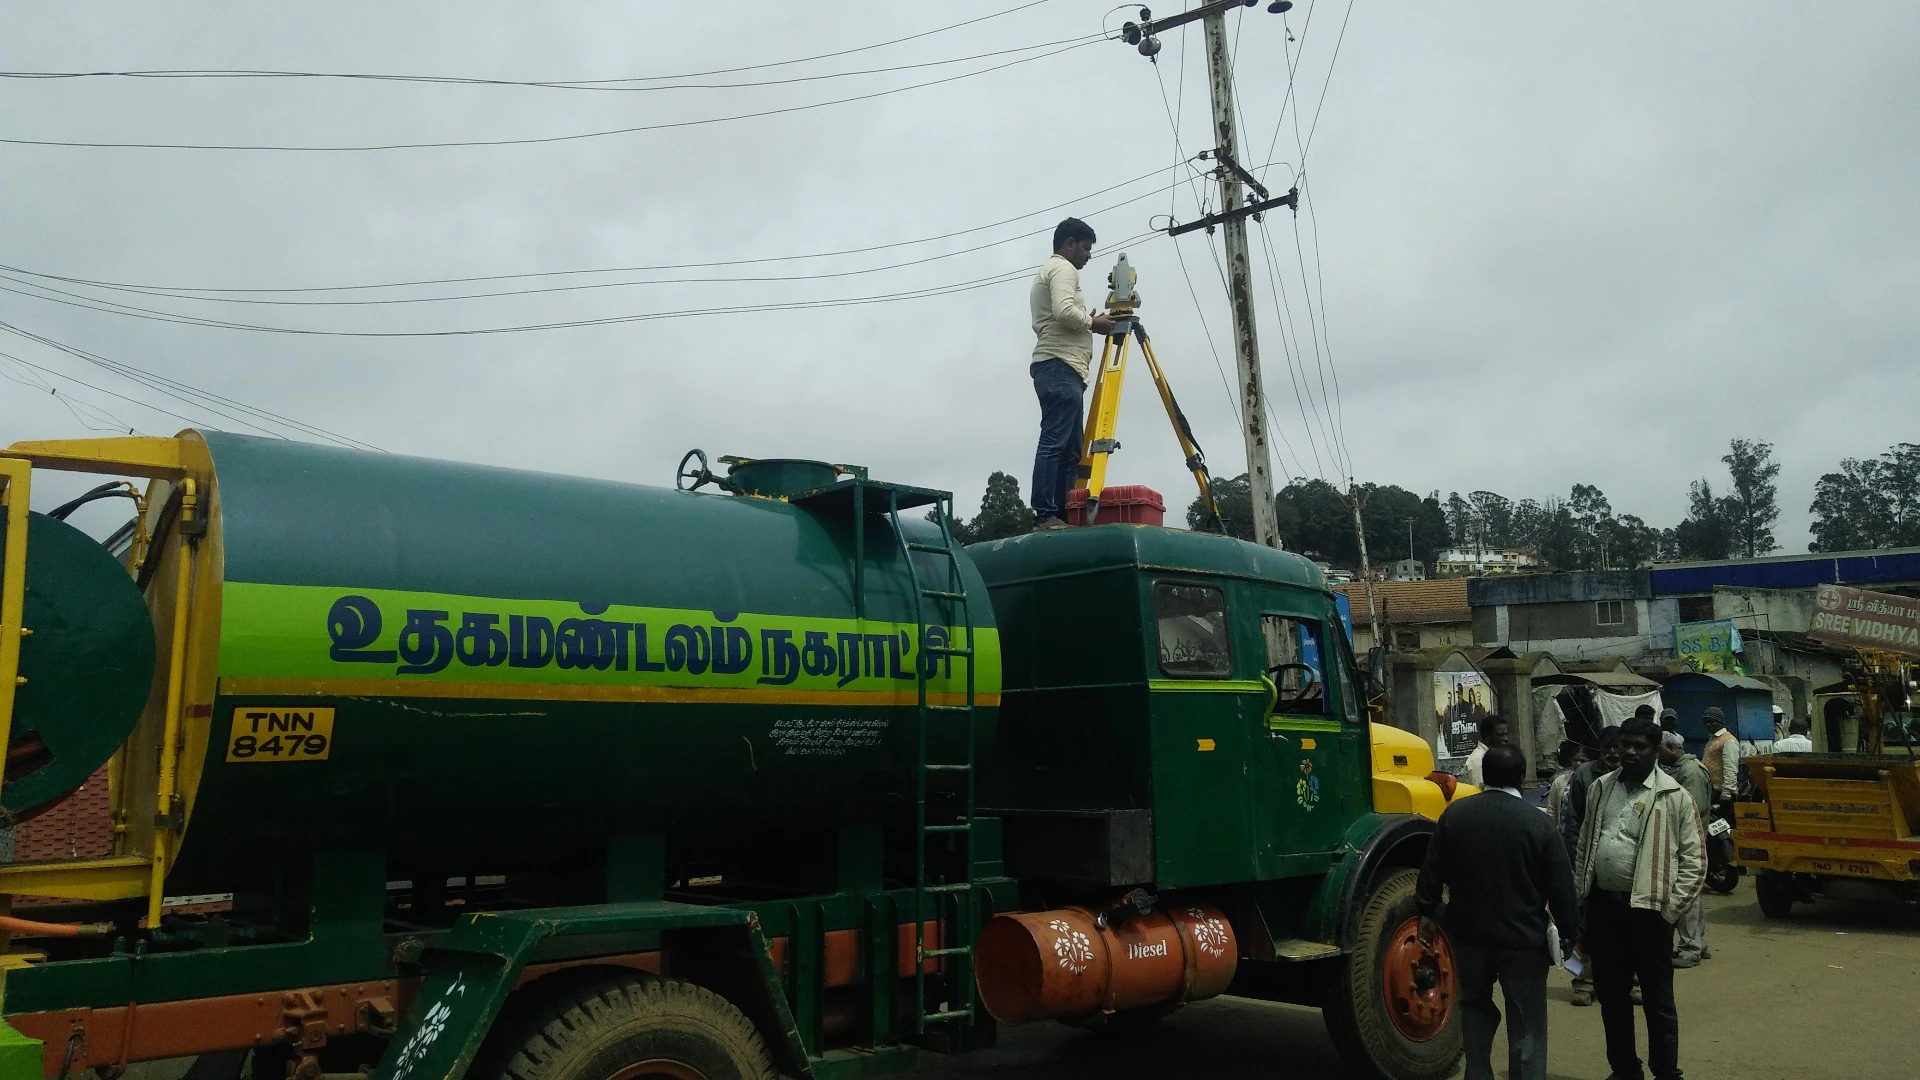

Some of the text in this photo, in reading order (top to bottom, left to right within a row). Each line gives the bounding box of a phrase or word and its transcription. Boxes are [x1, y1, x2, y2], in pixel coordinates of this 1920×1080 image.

[1815, 611, 1919, 646] SREE VIDHYA
[327, 594, 953, 689] உதகமண்டலம் நகராட்சி
[245, 711, 315, 733] TNN
[231, 734, 327, 759] 8479
[1128, 939, 1168, 960] Diesel
